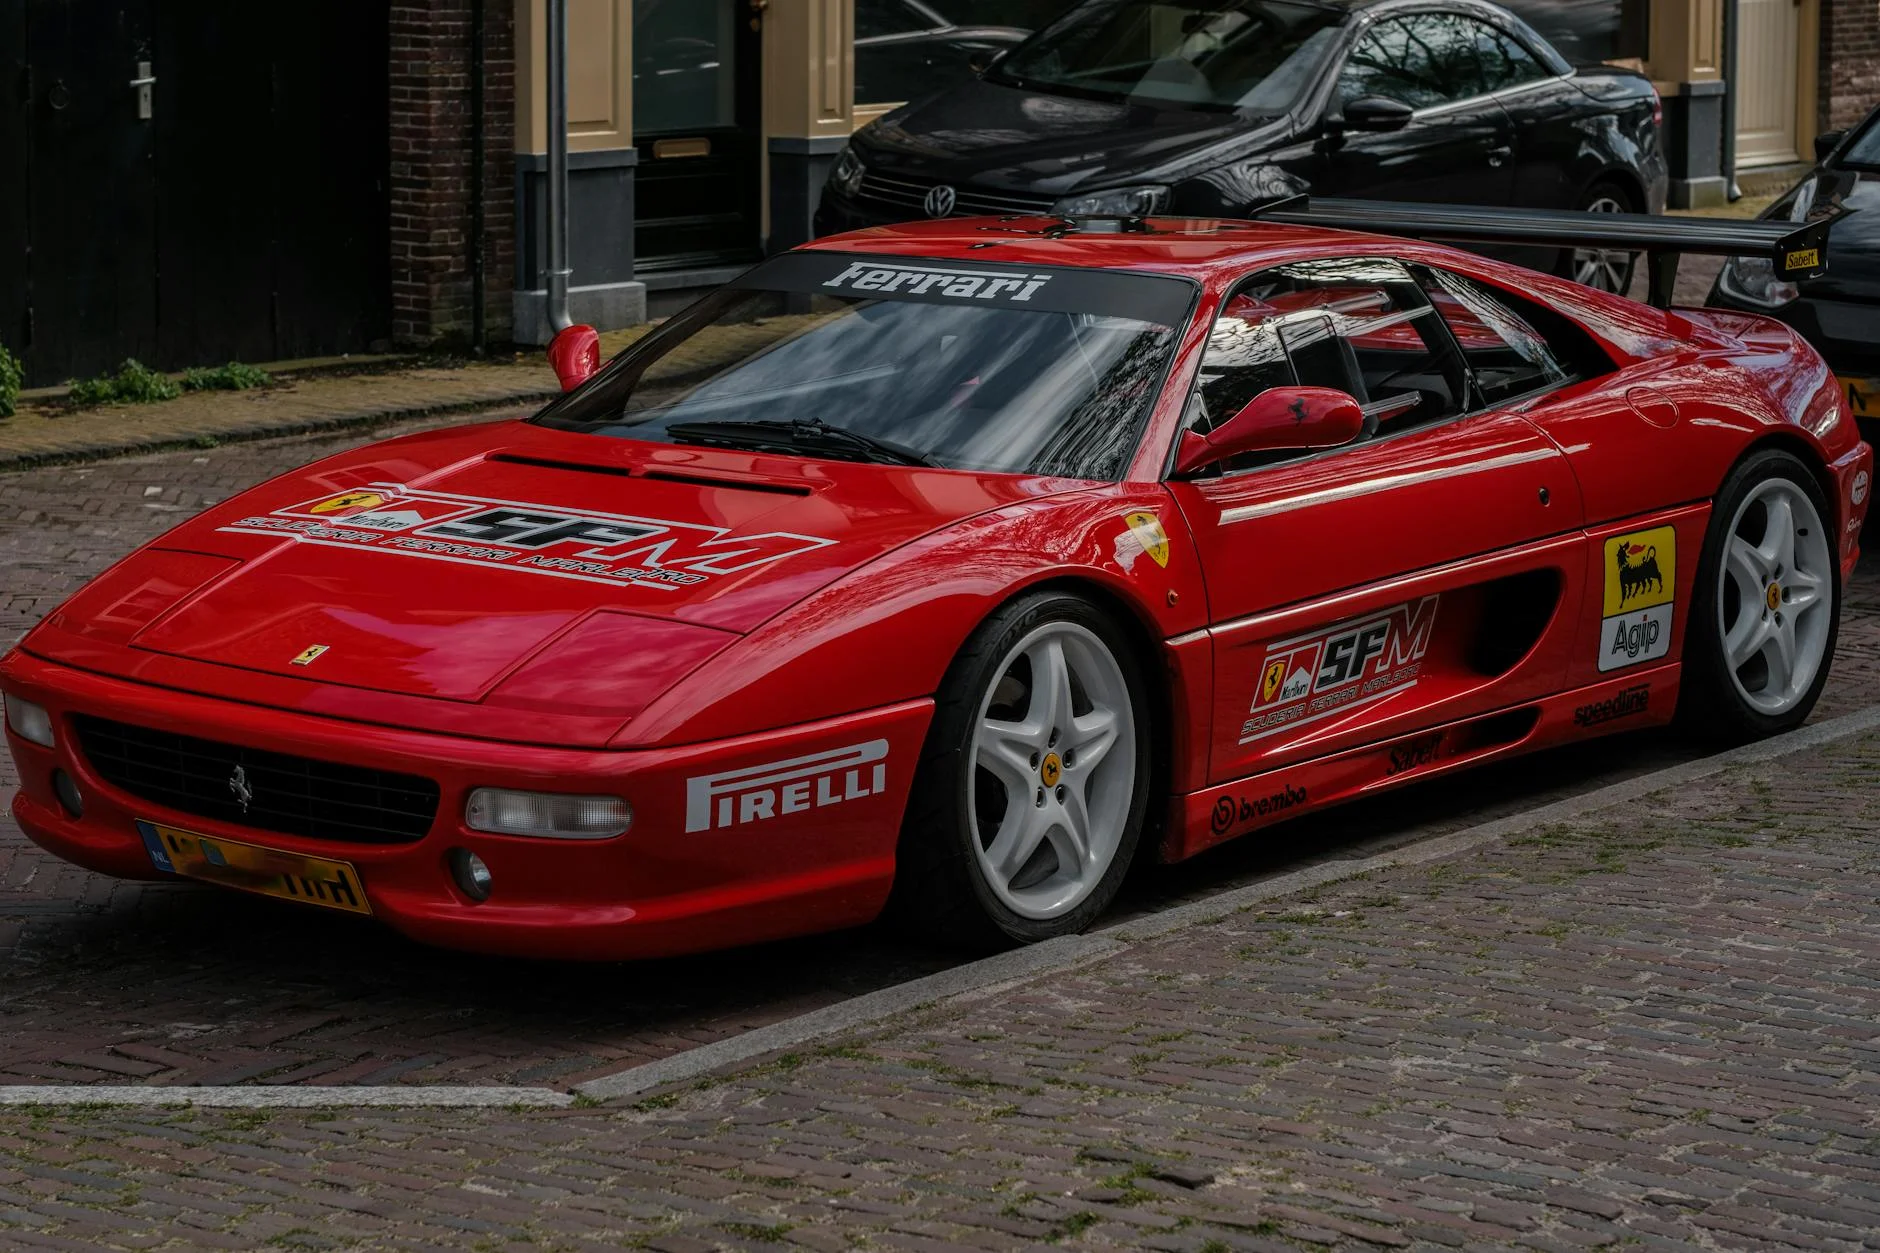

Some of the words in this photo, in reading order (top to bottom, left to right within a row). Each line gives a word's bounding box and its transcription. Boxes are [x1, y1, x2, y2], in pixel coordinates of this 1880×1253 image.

[822, 261, 1052, 301] Ferrari
[1788, 250, 1816, 269] Sabelt
[231, 517, 385, 543] SCUDERIA
[379, 536, 523, 561] FERRARI
[413, 507, 840, 575] SFM
[1313, 593, 1440, 693] SFM
[1611, 614, 1659, 658] Agip
[1241, 704, 1305, 734] SCUDERIA
[1308, 685, 1359, 713] FERRARI
[1361, 663, 1422, 695] MARLBORO
[1573, 684, 1650, 727] speedline
[685, 738, 889, 833] PIRELLI
[1239, 783, 1306, 820] brembo
[151, 849, 170, 864] NL
